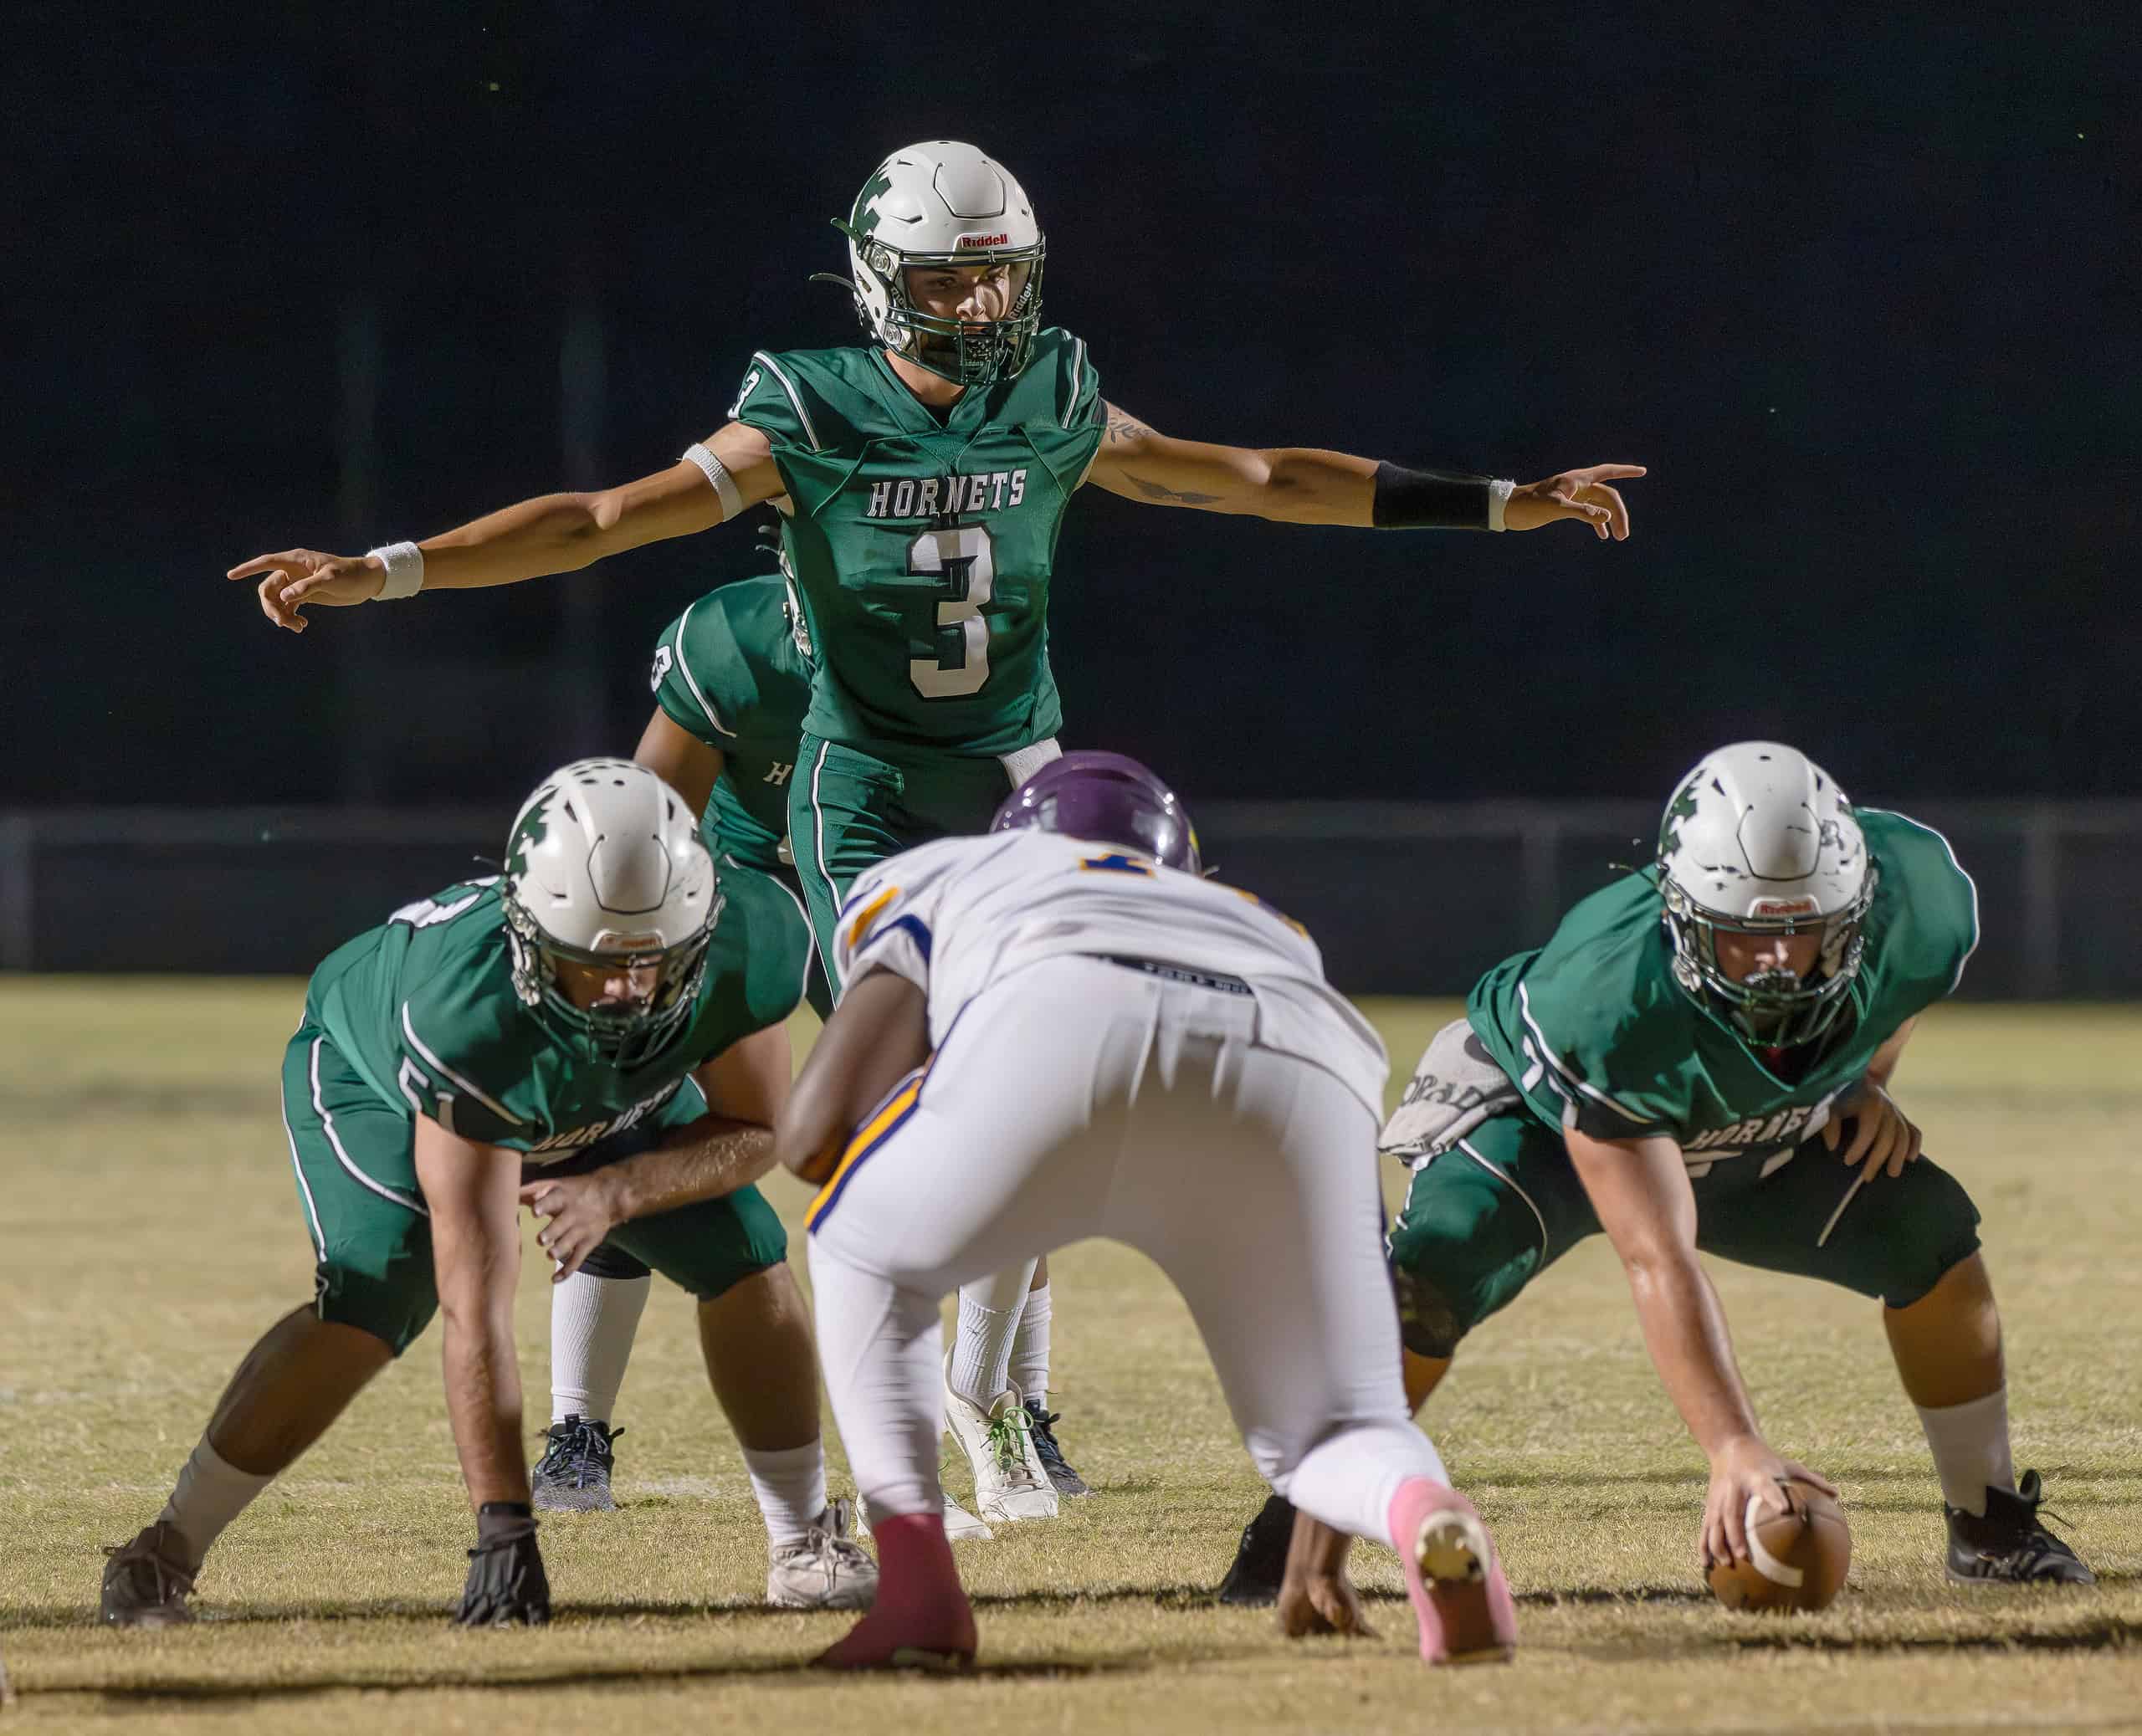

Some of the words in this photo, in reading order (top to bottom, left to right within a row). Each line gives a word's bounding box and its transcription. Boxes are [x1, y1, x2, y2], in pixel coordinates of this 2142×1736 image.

[961, 233, 1008, 248] Riddell
[867, 469, 1027, 518] HORNETS
[909, 525, 994, 699] 3
